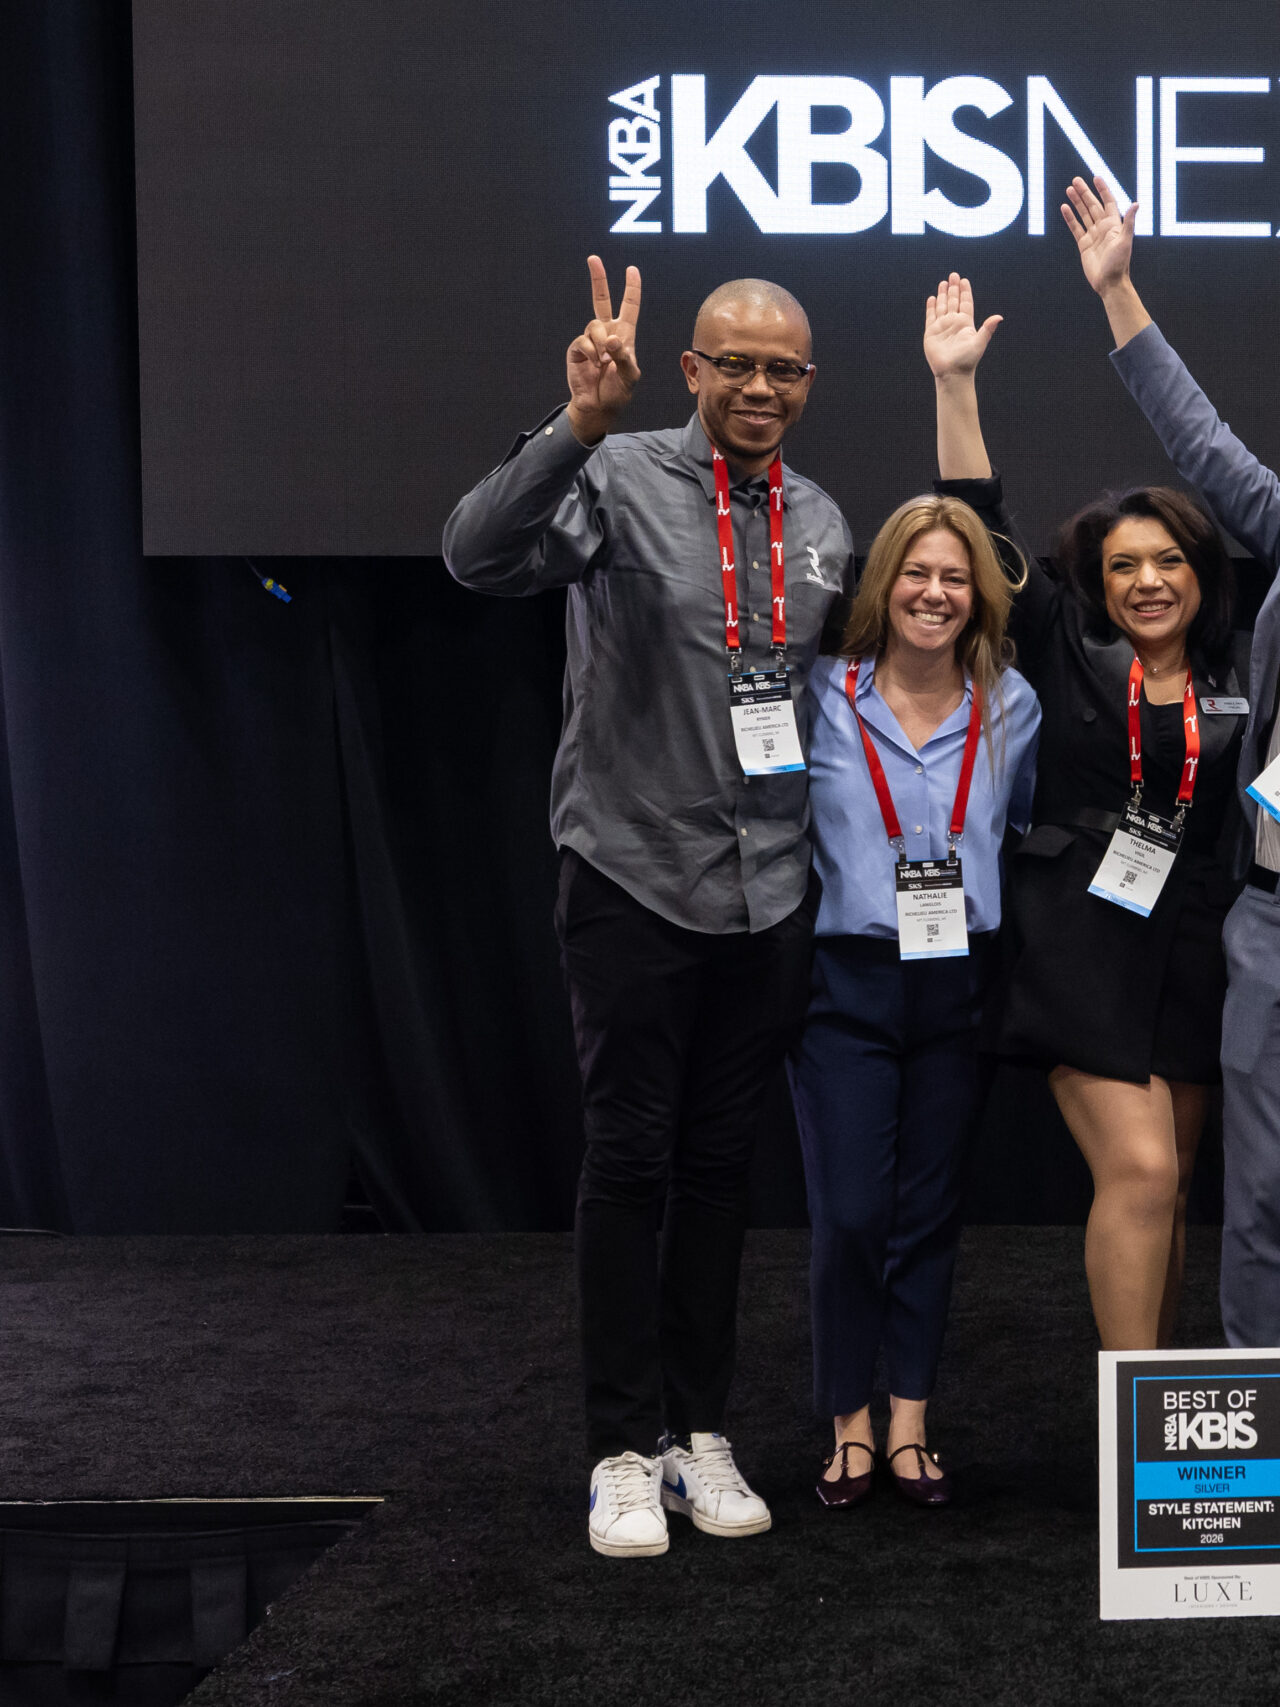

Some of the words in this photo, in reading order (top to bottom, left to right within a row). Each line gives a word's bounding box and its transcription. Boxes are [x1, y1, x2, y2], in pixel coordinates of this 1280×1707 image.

[1130, 838, 1156, 855] THELMA
[913, 892, 947, 900] NATHALIE
[1164, 1391, 1220, 1409] BEST
[1228, 1390, 1257, 1408] OF
[1179, 1411, 1258, 1450] KBIS
[1178, 1466, 1246, 1480] WINNER
[1195, 1484, 1229, 1494] SILVER
[1149, 1503, 1190, 1515] STYLE
[1194, 1501, 1274, 1513] STATEMENT:
[1183, 1517, 1241, 1530] KITCHEN
[1201, 1534, 1223, 1543] 2026
[1175, 1581, 1252, 1602] LUXE
